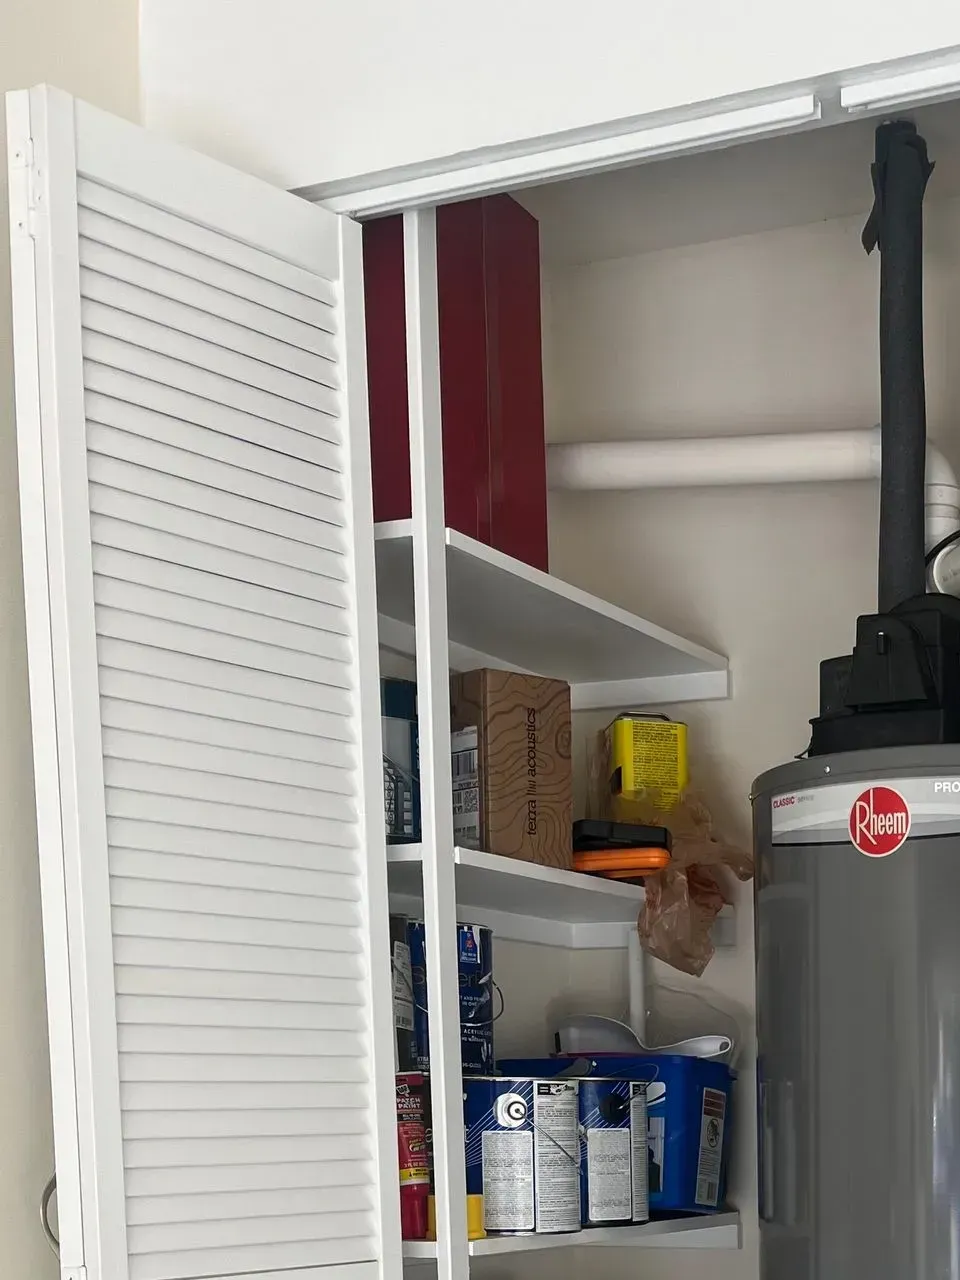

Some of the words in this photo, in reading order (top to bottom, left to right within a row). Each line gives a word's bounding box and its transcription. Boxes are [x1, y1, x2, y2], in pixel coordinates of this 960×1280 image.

[526, 707, 537, 777] acoustics
[526, 799, 537, 836] terra
[773, 796, 795, 809] CLASSIC
[856, 788, 907, 846] Rheem
